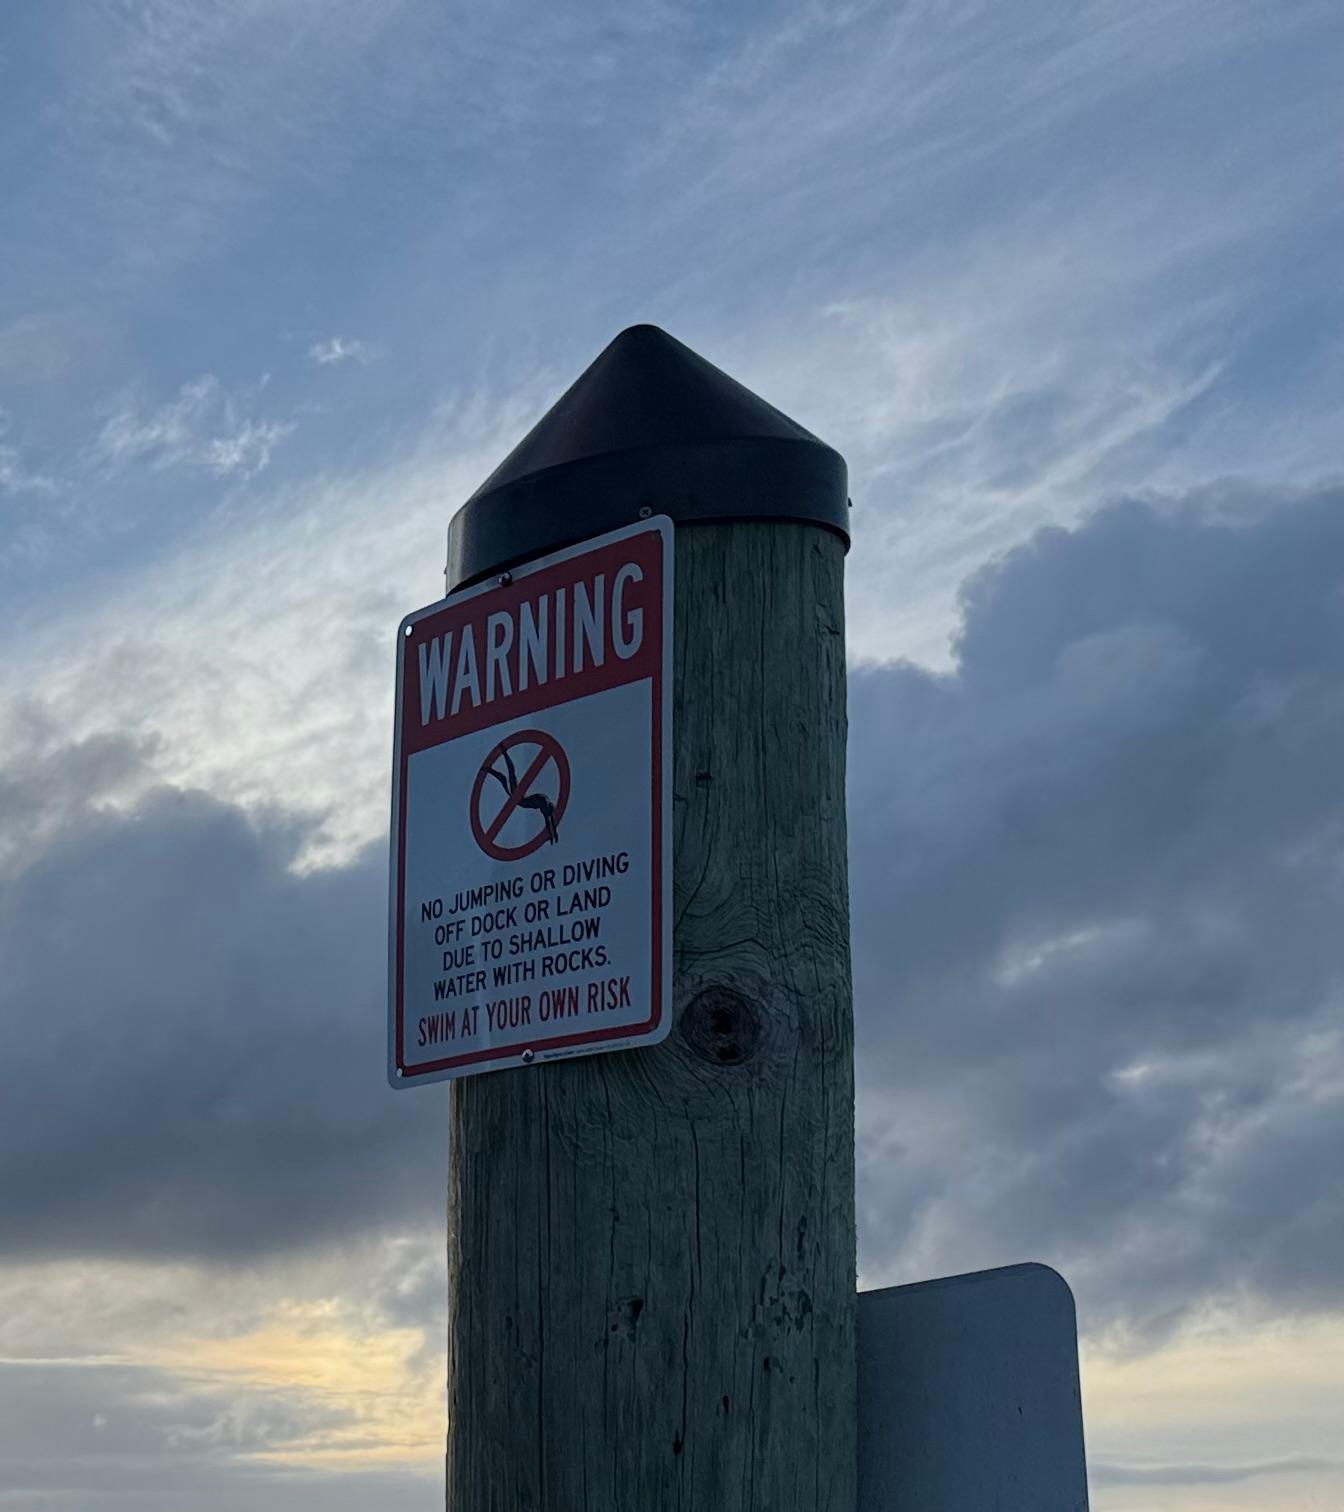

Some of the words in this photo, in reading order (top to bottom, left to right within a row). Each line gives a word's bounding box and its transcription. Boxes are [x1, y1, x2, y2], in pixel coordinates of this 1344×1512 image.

[418, 562, 644, 727] WARNING
[421, 898, 443, 922] NO
[449, 877, 524, 914] JUMPING
[530, 869, 555, 893] OR
[563, 852, 629, 886] DIVING
[435, 920, 465, 945] OFF
[471, 906, 517, 936] DOCK
[524, 900, 549, 923] OR
[557, 886, 611, 916] LAND
[434, 970, 487, 1000] WATER
[493, 959, 535, 987] WITH
[542, 945, 611, 977] ROCKS.
[443, 945, 474, 971] DUE
[481, 938, 502, 962] TO
[509, 917, 601, 955] SHALLOW
[418, 1011, 455, 1047] SWIM
[461, 1005, 480, 1038] AT
[486, 995, 531, 1032] YOUR
[539, 986, 579, 1022] OWN
[587, 976, 631, 1014] RISK
